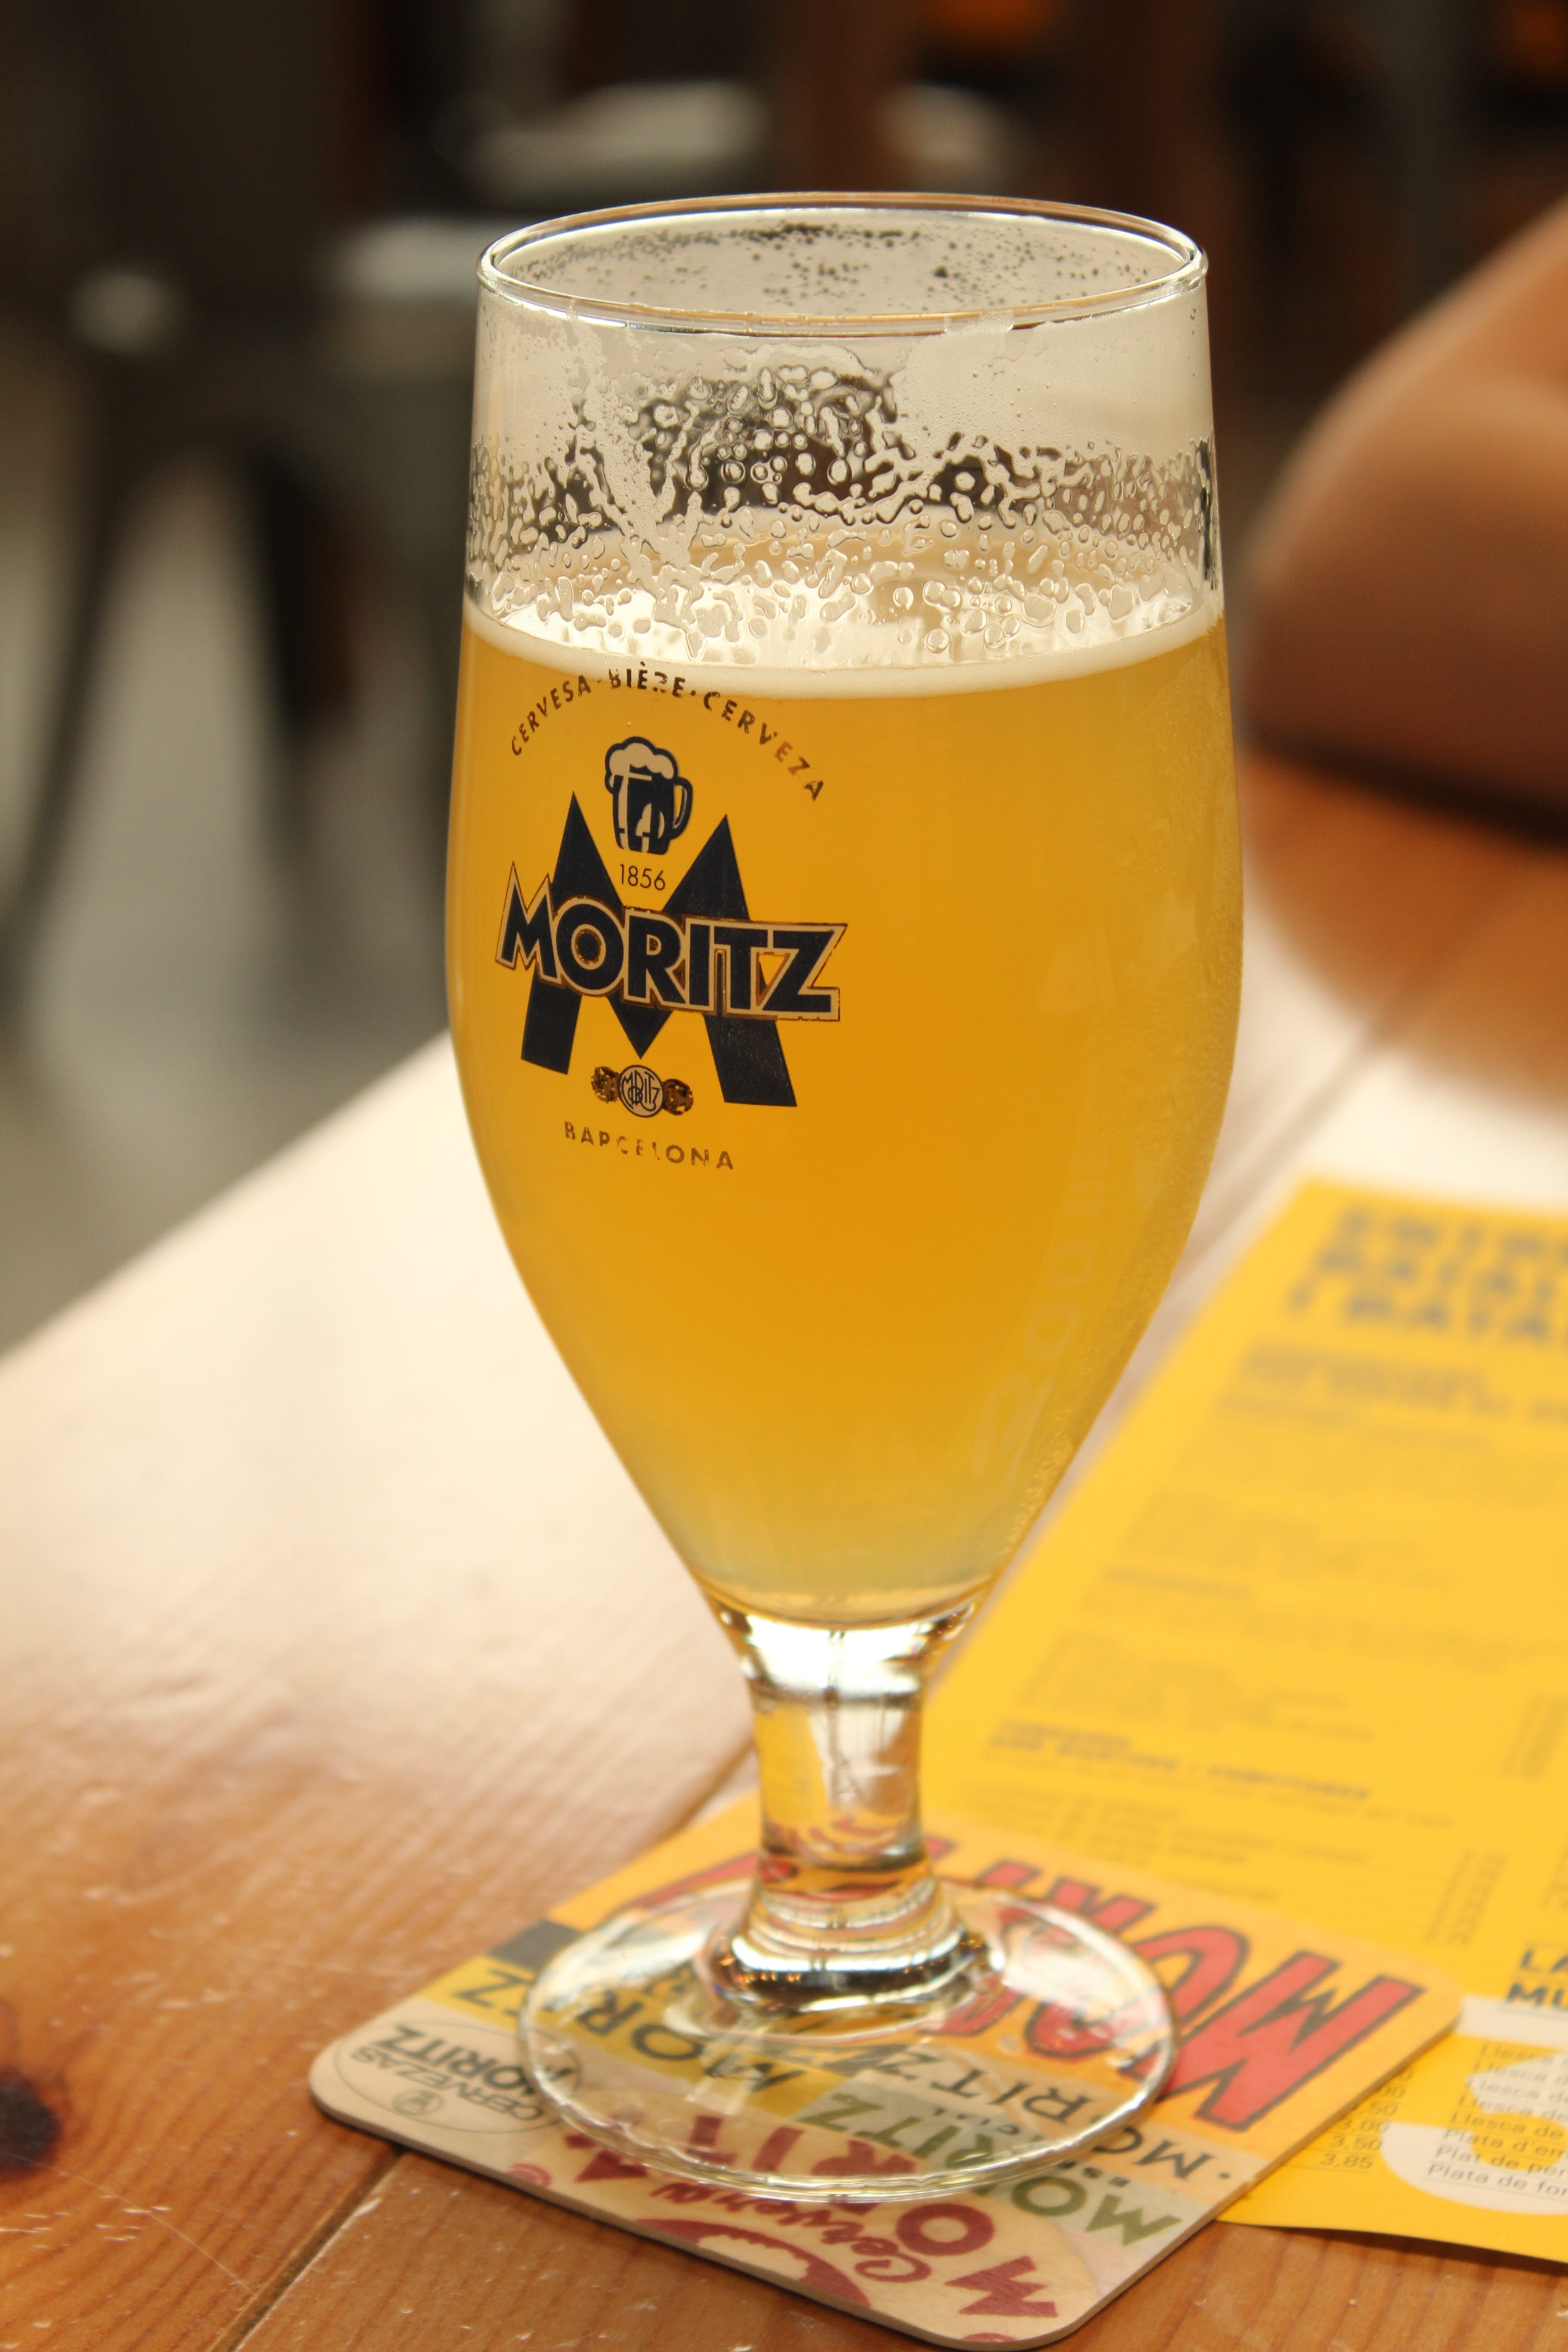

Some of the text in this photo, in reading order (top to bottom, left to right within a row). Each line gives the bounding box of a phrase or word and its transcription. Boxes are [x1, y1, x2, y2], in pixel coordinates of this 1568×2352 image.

[511, 674, 591, 756] CERVESA
[703, 691, 824, 801] CERVEZA
[619, 863, 666, 892] 1856
[495, 861, 848, 1022] MORITZ
[348, 2045, 543, 2121] CERVEZAS
[1534, 2125, 1563, 2140] de
[1428, 2164, 1489, 2183] Plata
[1498, 2176, 1527, 2190] de
[1490, 2156, 1519, 2170] de
